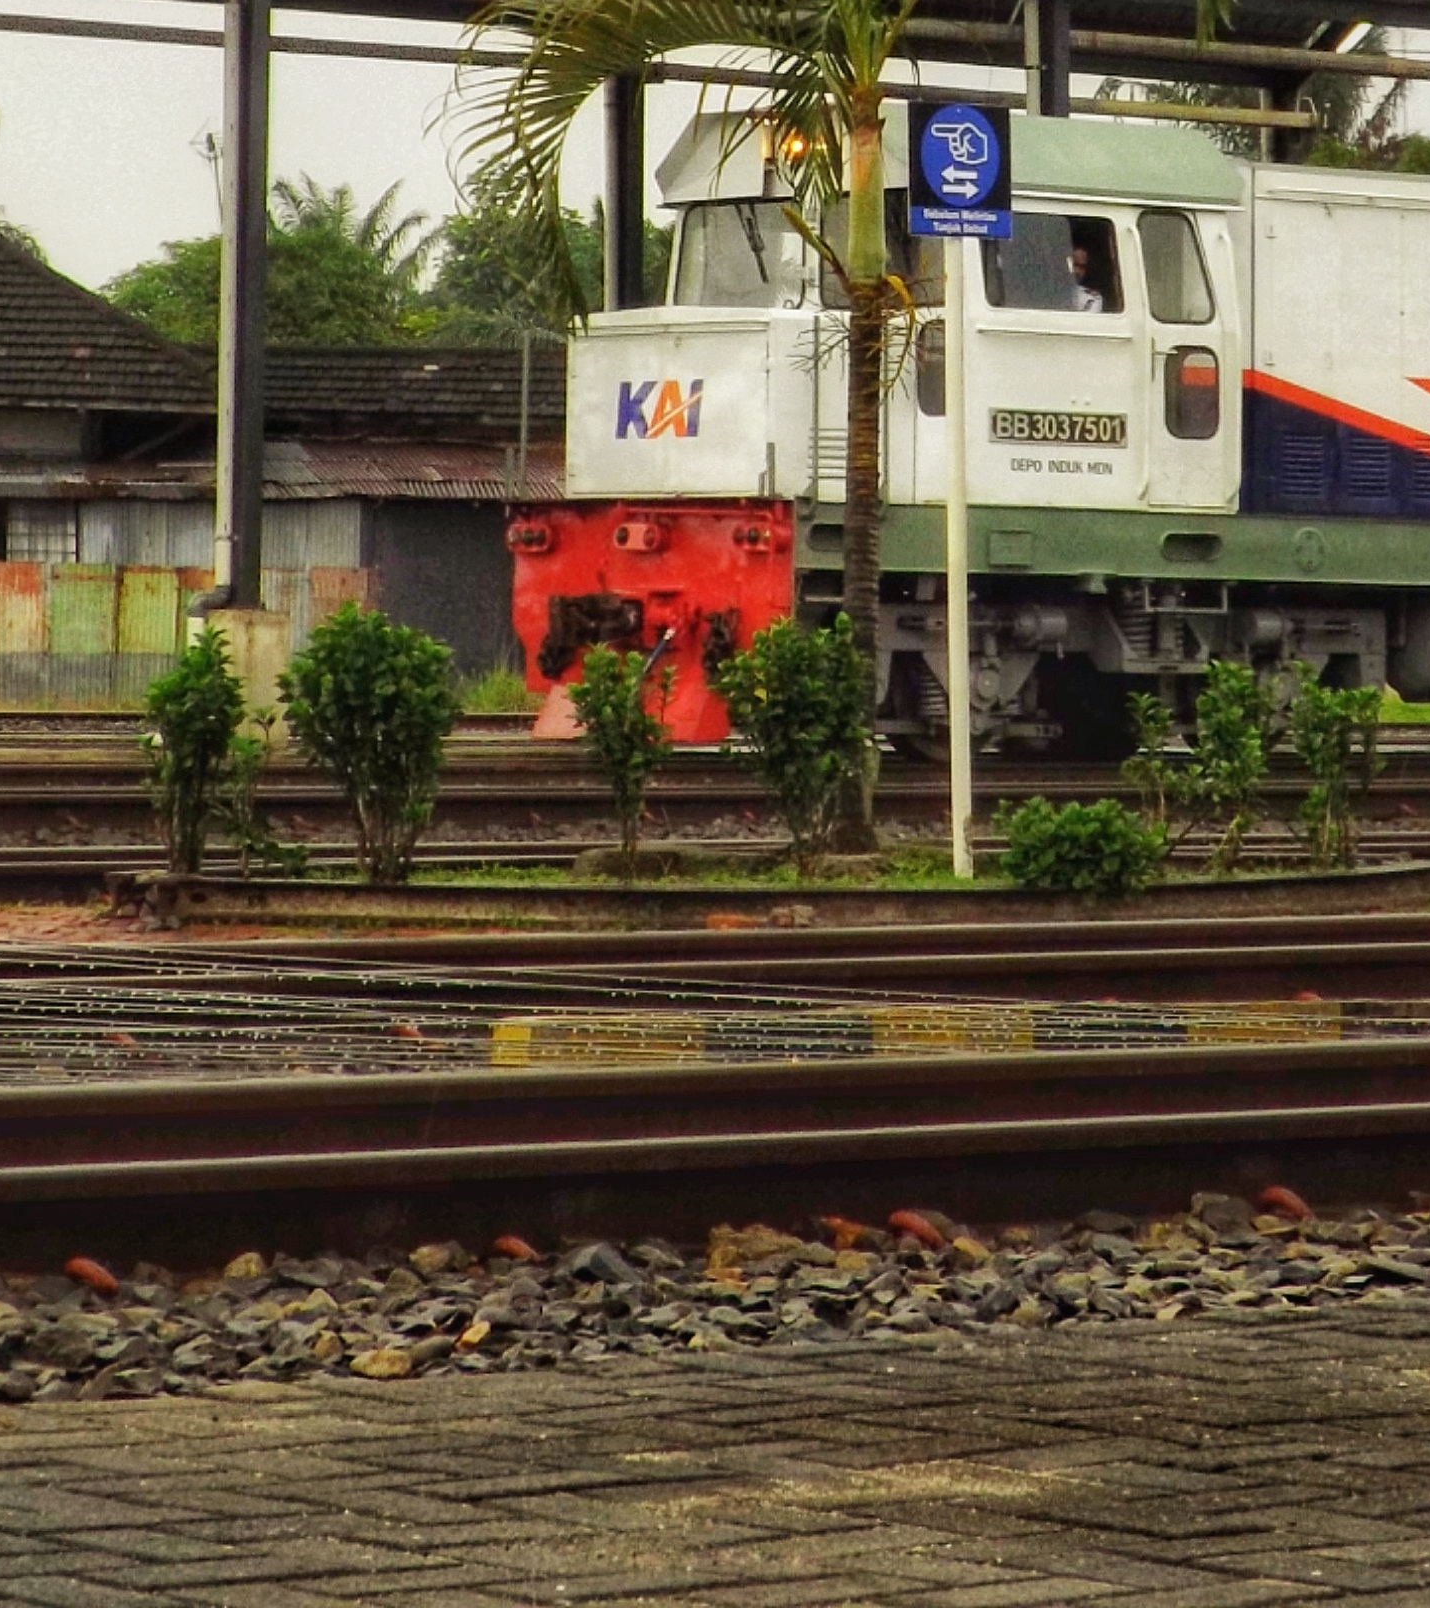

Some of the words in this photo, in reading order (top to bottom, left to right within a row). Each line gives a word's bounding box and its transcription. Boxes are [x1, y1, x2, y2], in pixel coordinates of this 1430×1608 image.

[615, 378, 704, 440] KAI
[1010, 457, 1043, 473] DEPO
[1048, 459, 1084, 475] INDUK
